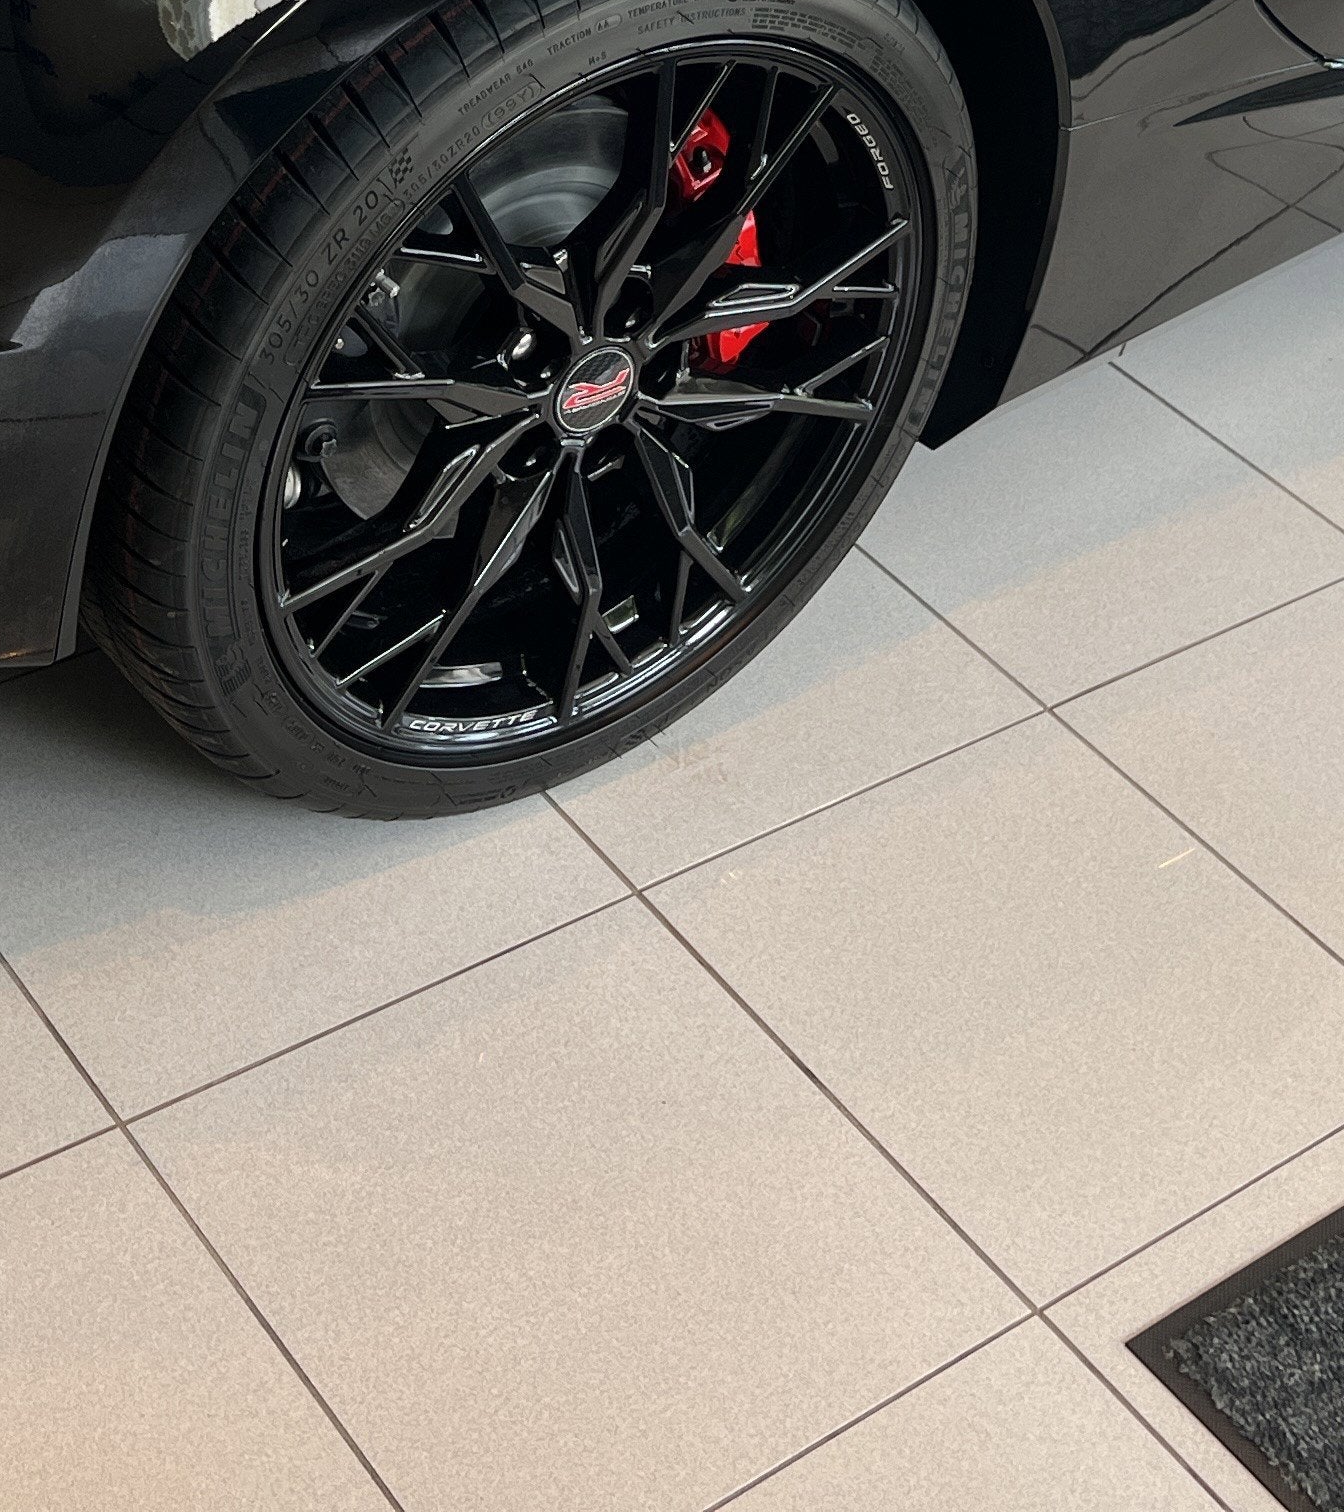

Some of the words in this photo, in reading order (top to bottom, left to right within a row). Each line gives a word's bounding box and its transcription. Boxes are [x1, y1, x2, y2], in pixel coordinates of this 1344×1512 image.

[637, 15, 675, 36] SAFETY
[679, 7, 747, 23] INSTRUCTIONS
[457, 73, 512, 115] TREADWEAR
[546, 27, 592, 56] TRACTION
[845, 113, 895, 190] FORGED
[258, 268, 320, 366] 305/30
[320, 227, 347, 266] ZR
[352, 190, 380, 227] 20
[201, 400, 259, 638] MICHELIN
[408, 709, 540, 734] CORVETTE
